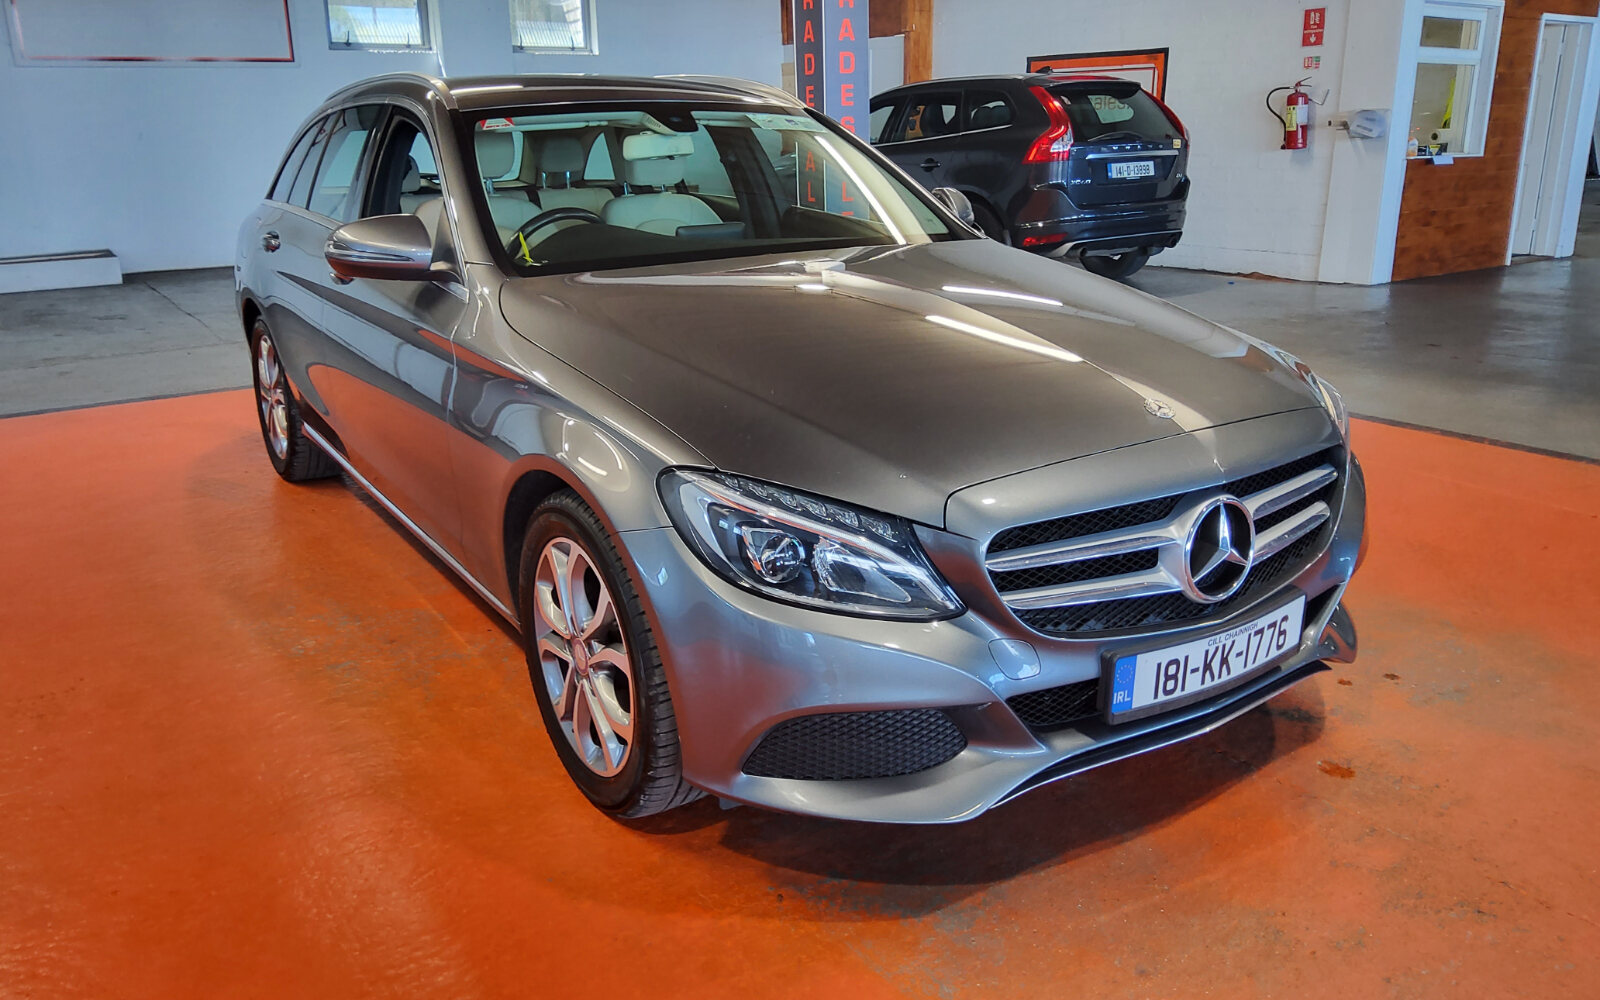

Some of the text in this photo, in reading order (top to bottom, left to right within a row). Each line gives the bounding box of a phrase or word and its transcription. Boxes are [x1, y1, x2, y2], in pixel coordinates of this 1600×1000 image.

[1207, 636, 1223, 647] CILL
[1153, 614, 1290, 700] 181-KK-1776
[1112, 689, 1132, 705] IRL
